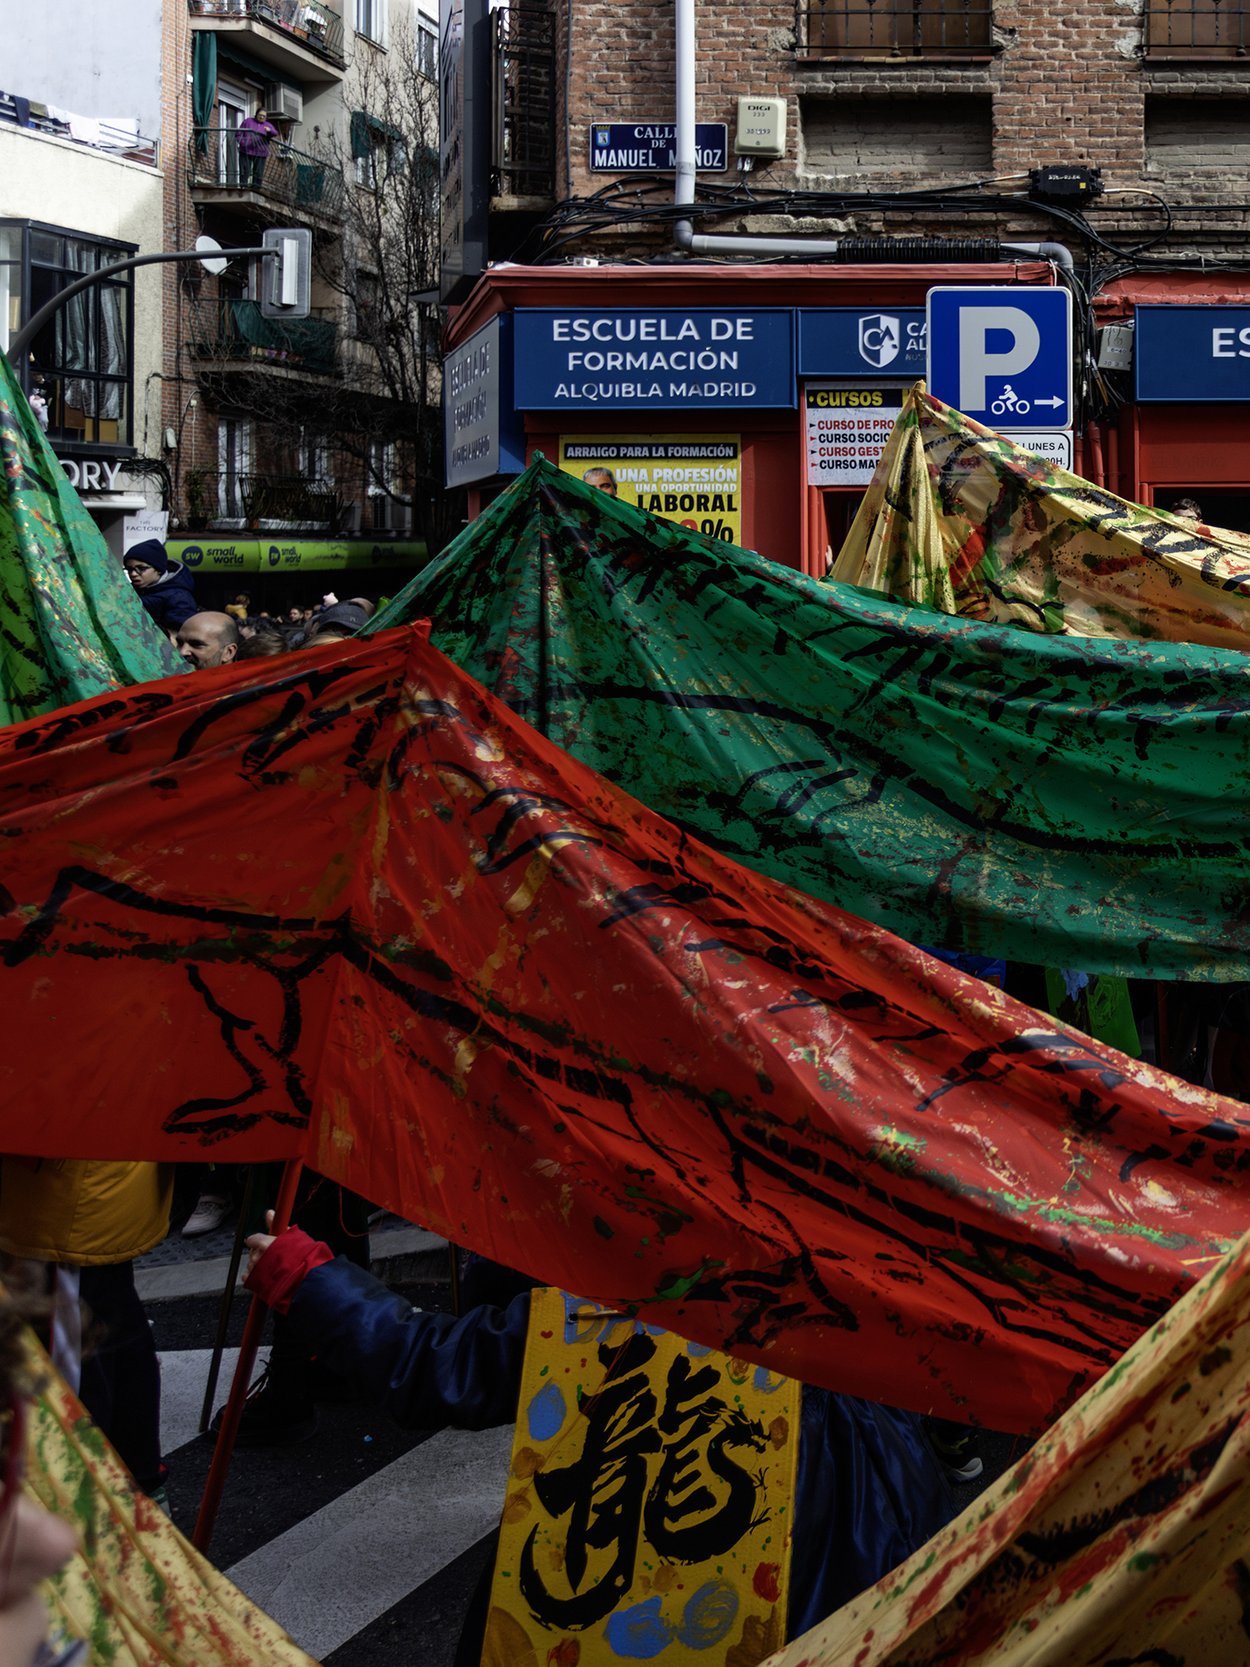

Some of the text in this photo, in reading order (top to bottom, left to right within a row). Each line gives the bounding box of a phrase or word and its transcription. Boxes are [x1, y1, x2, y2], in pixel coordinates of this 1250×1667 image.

[651, 140, 666, 148] DE
[594, 145, 722, 167] MANUEL MÑOZ
[552, 318, 754, 342] ESCUELA DE
[906, 322, 927, 337] CA
[905, 338, 927, 351] AL
[568, 346, 739, 371] FORMACIÓN
[959, 306, 1041, 412] P
[554, 382, 757, 400] ALQUIBLA MADRID
[816, 391, 883, 407] cursos
[817, 419, 895, 430] CURSO DE PRO
[818, 432, 890, 443] CURSO SOCIO
[566, 445, 734, 457] ARRAIGO PARA LA FORMACIÓN
[818, 446, 886, 457] CURSO GES
[1057, 442, 1065, 450] A
[819, 459, 881, 470] CURSO MA
[58, 459, 122, 491] ORY
[615, 465, 737, 482] UNA PROFESIÓN
[635, 484, 737, 493] UNA OPORTUNIDAD
[637, 494, 738, 512] LABORAL
[206, 546, 236, 556] small
[213, 553, 244, 564] world
